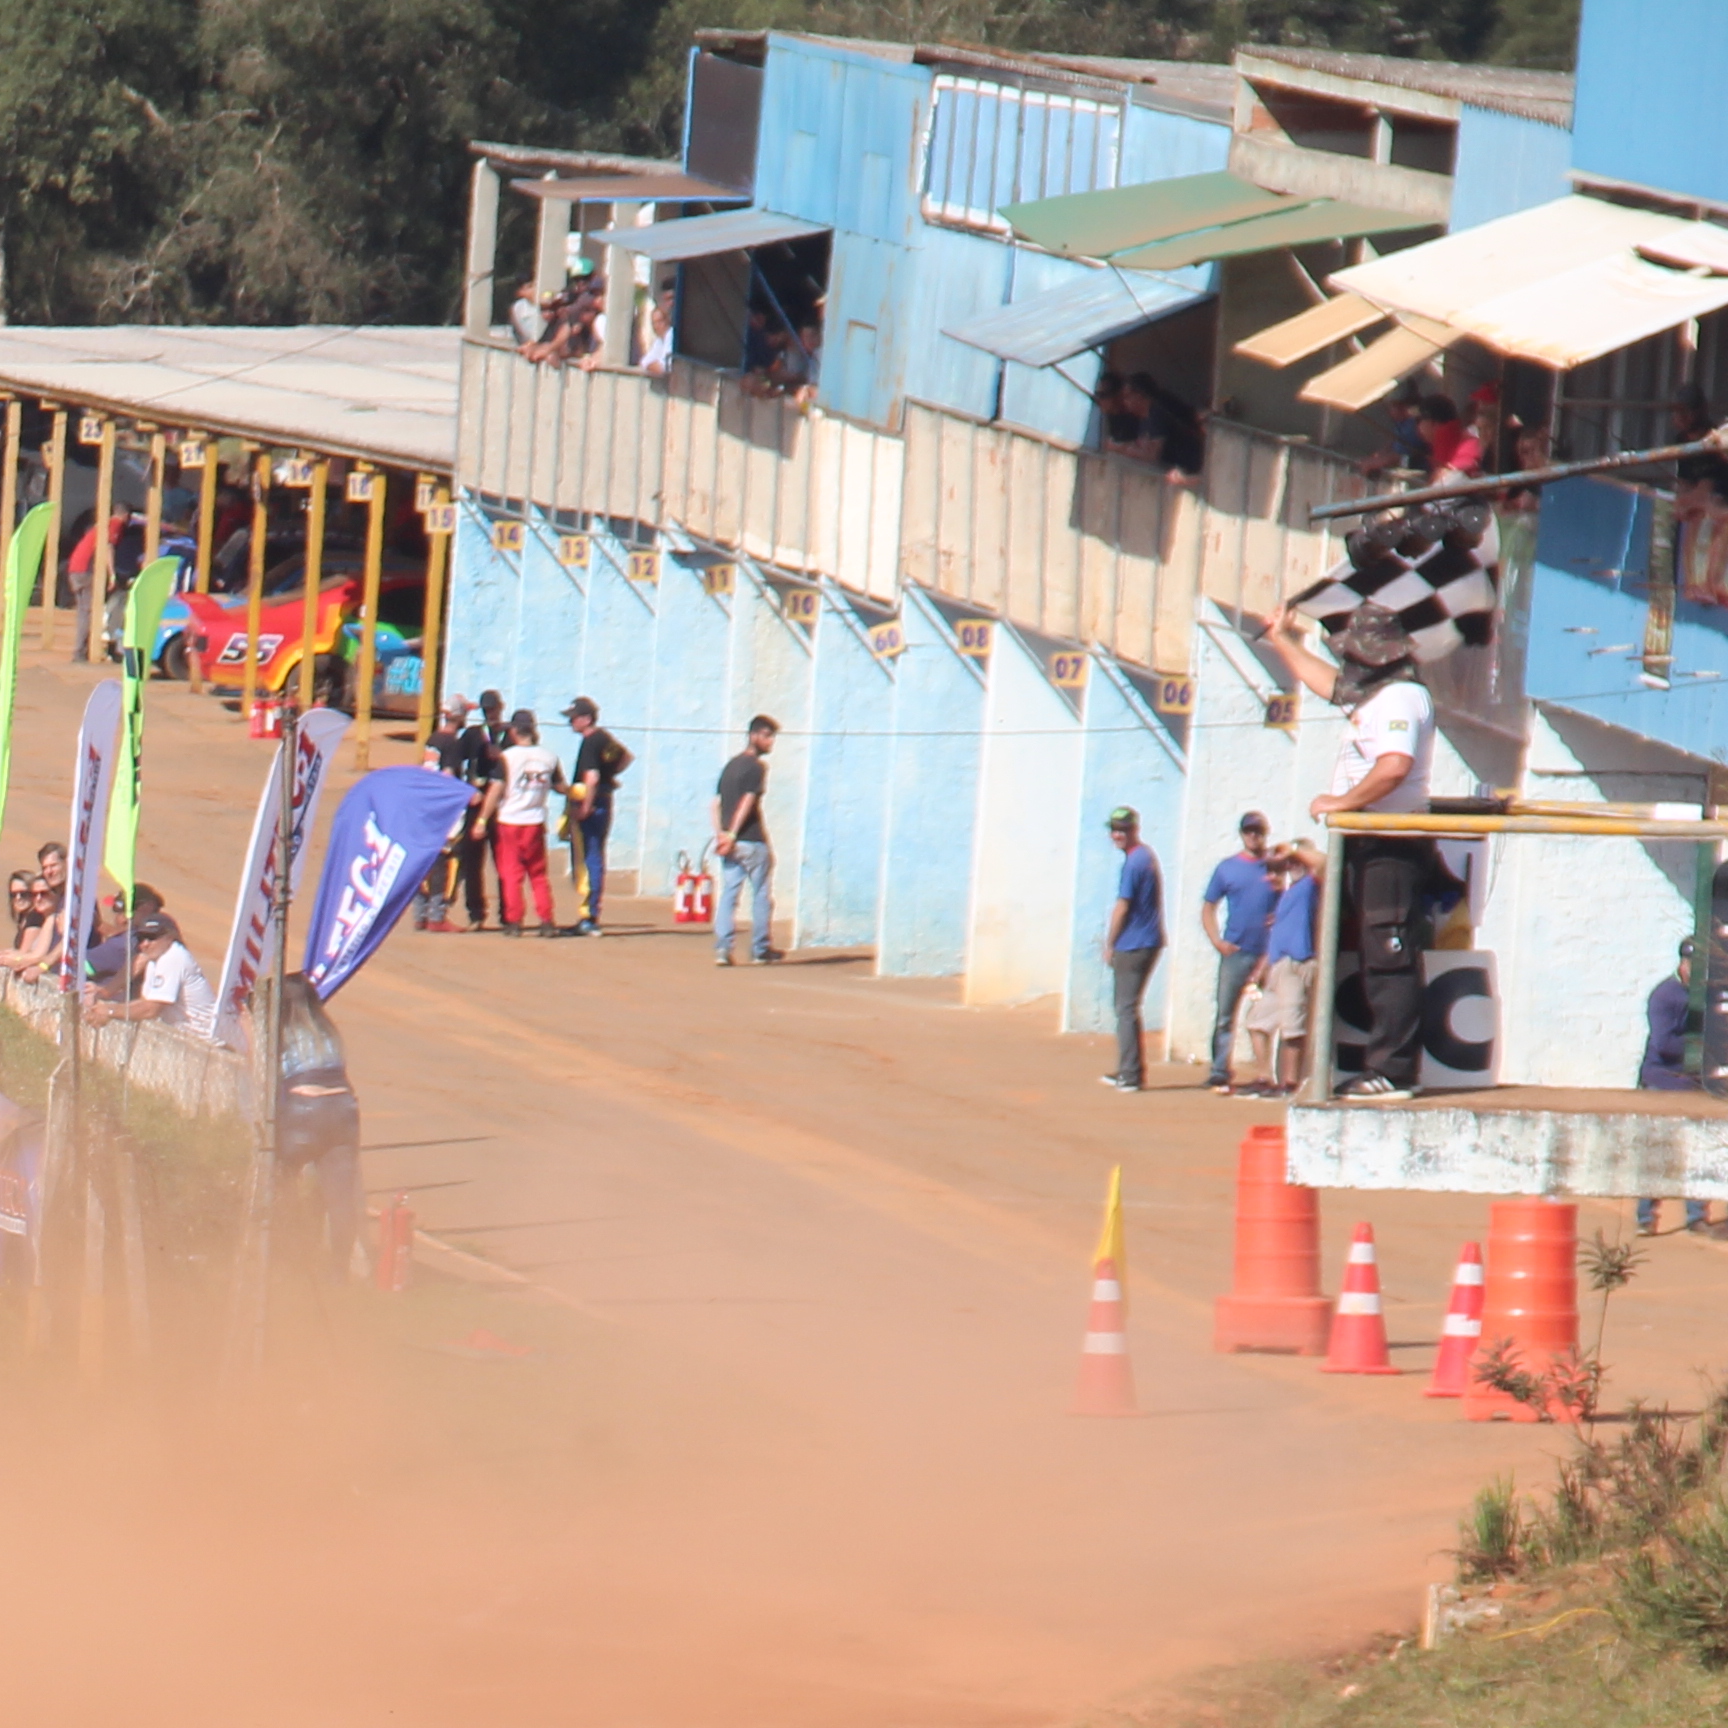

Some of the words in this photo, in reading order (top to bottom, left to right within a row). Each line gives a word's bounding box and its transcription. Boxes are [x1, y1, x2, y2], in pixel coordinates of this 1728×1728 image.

[497, 526, 519, 545] 14
[563, 540, 585, 560] 13
[632, 556, 654, 577] 12
[707, 567, 729, 589] 11
[791, 594, 815, 615] 10
[962, 625, 989, 648] 08
[1054, 657, 1082, 679] 07
[1163, 683, 1192, 707] 06
[1267, 699, 1294, 724] 05
